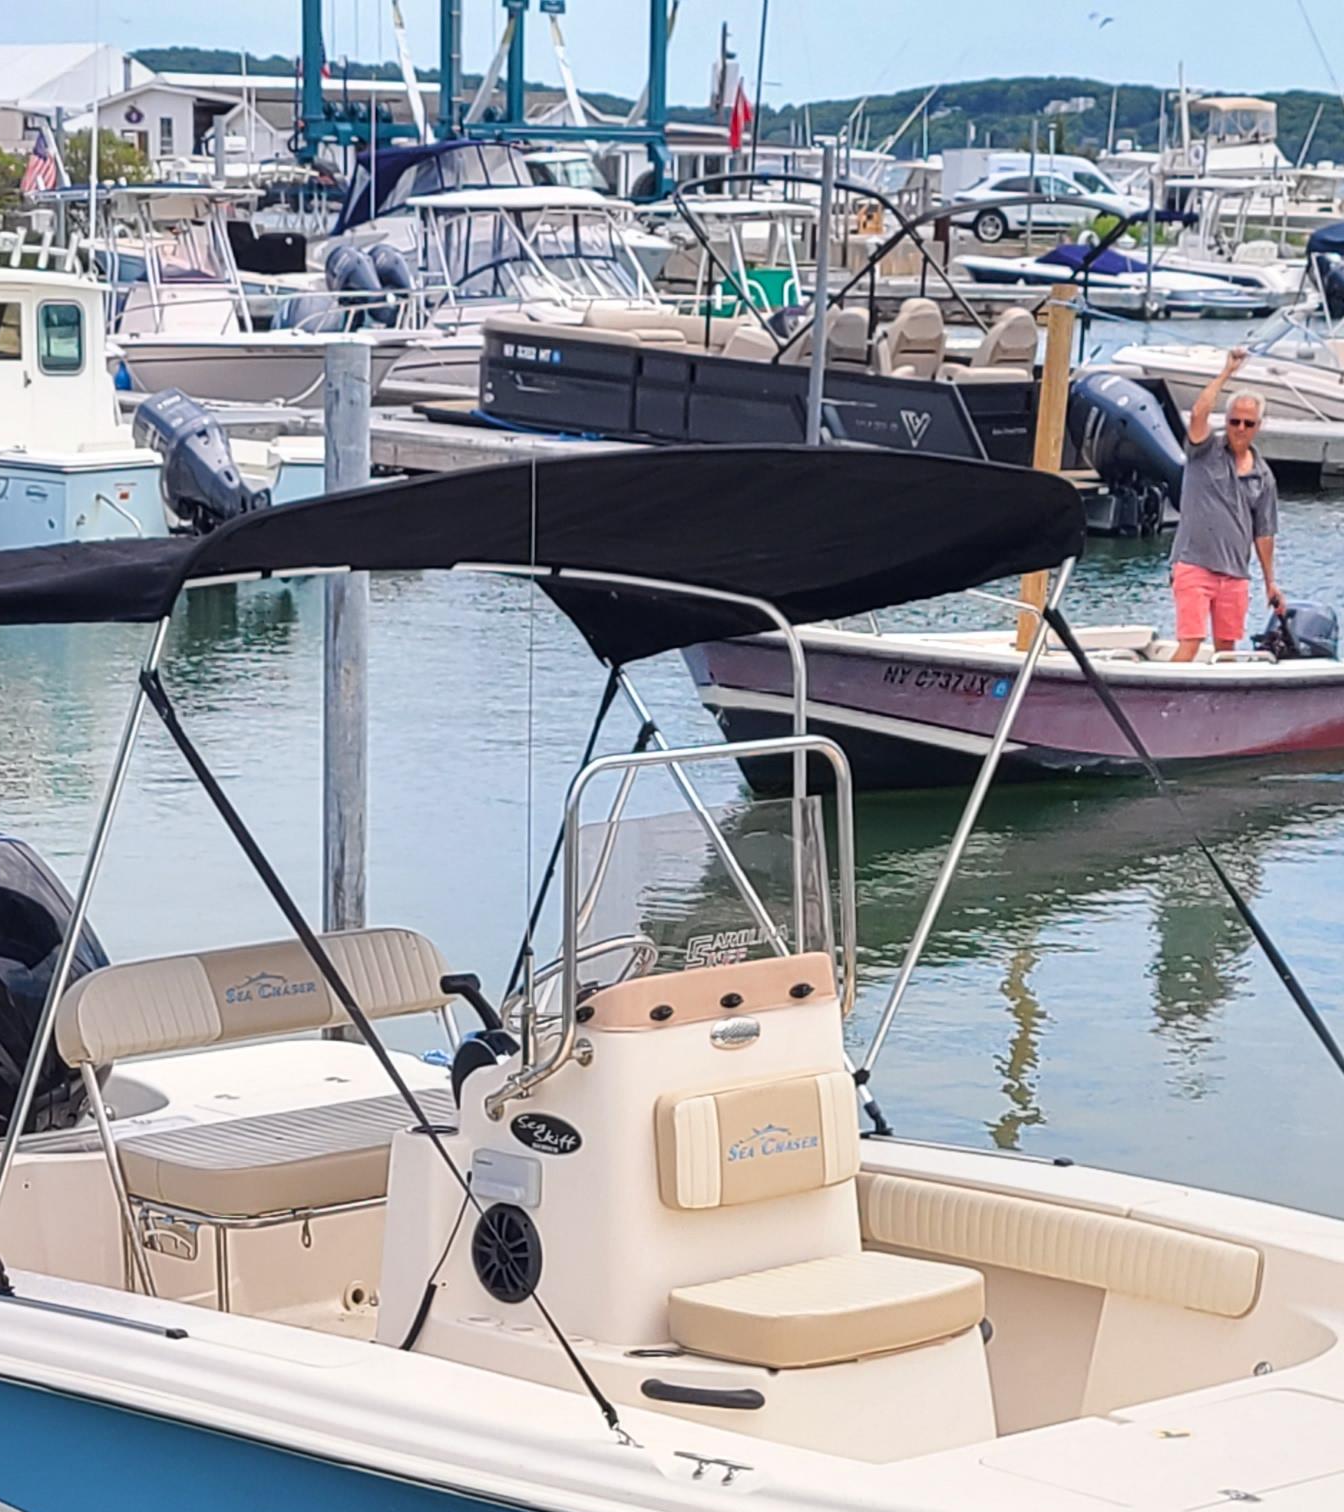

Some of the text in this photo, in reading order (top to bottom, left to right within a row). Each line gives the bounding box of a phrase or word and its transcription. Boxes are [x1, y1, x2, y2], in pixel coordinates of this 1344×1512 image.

[883, 665, 912, 685] NY
[225, 982, 316, 1004] SEA CHASER
[518, 1115, 546, 1132] Sea
[533, 1129, 577, 1151] Skiff
[728, 1136, 818, 1161] SEA CHASER
